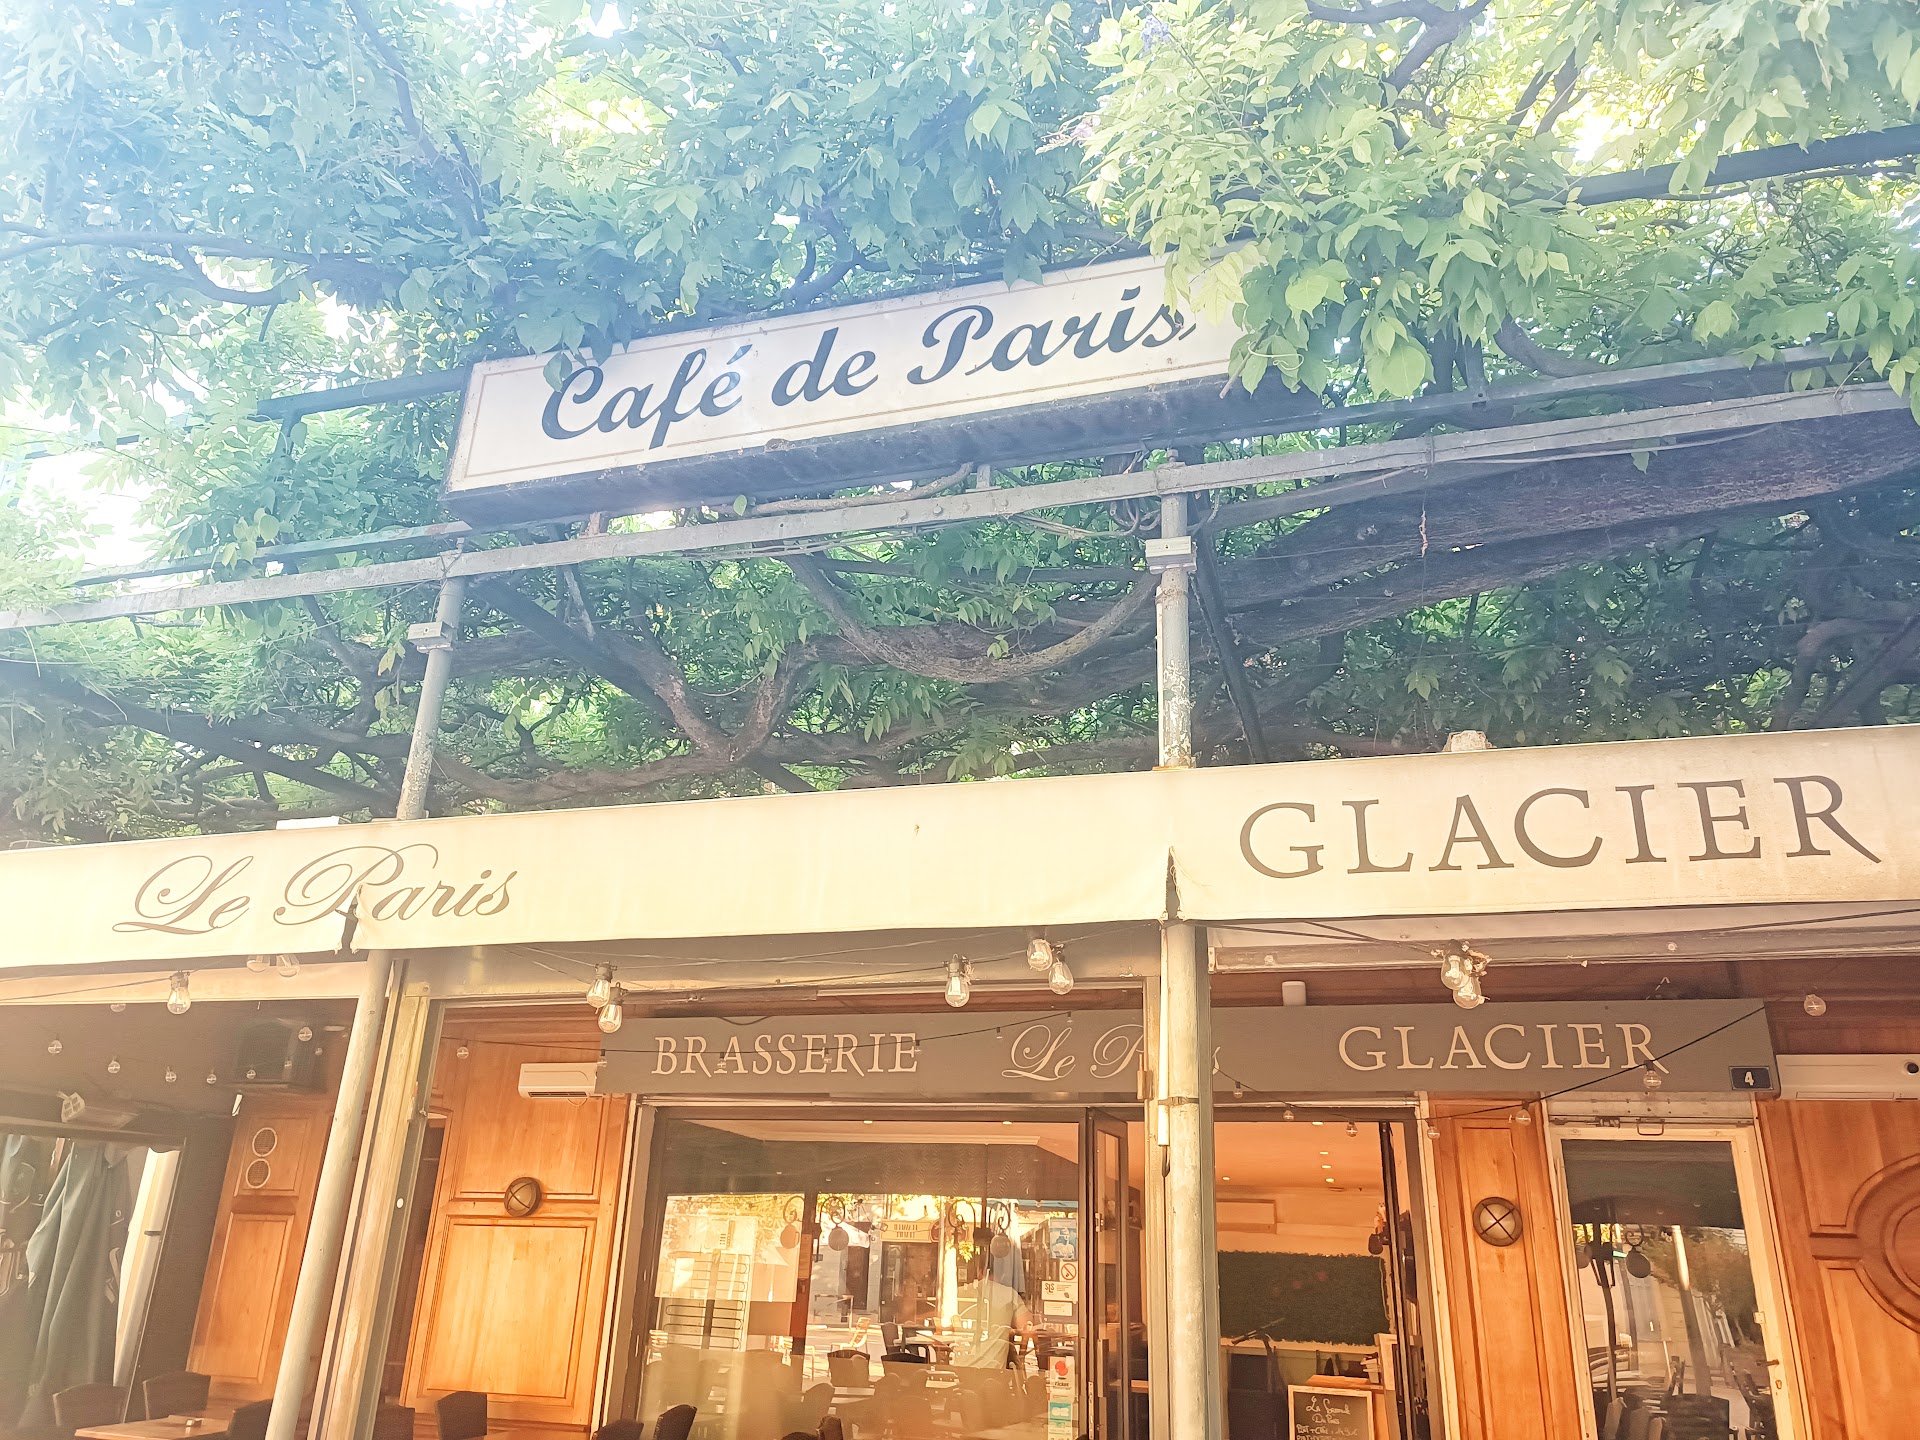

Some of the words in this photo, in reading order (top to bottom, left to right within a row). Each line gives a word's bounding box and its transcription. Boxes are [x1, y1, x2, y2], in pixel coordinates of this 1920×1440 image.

[541, 344, 754, 449] Café
[770, 326, 878, 407] de
[907, 286, 1198, 386] Paris
[1239, 774, 1882, 879] GLACIER
[112, 855, 254, 936] Le
[272, 843, 519, 925] Paris
[651, 1032, 919, 1078] BRASSERIE
[1001, 1024, 1076, 1082] Le
[1338, 1022, 1670, 1074] GLACIER
[1744, 1071, 1755, 1086] 4
